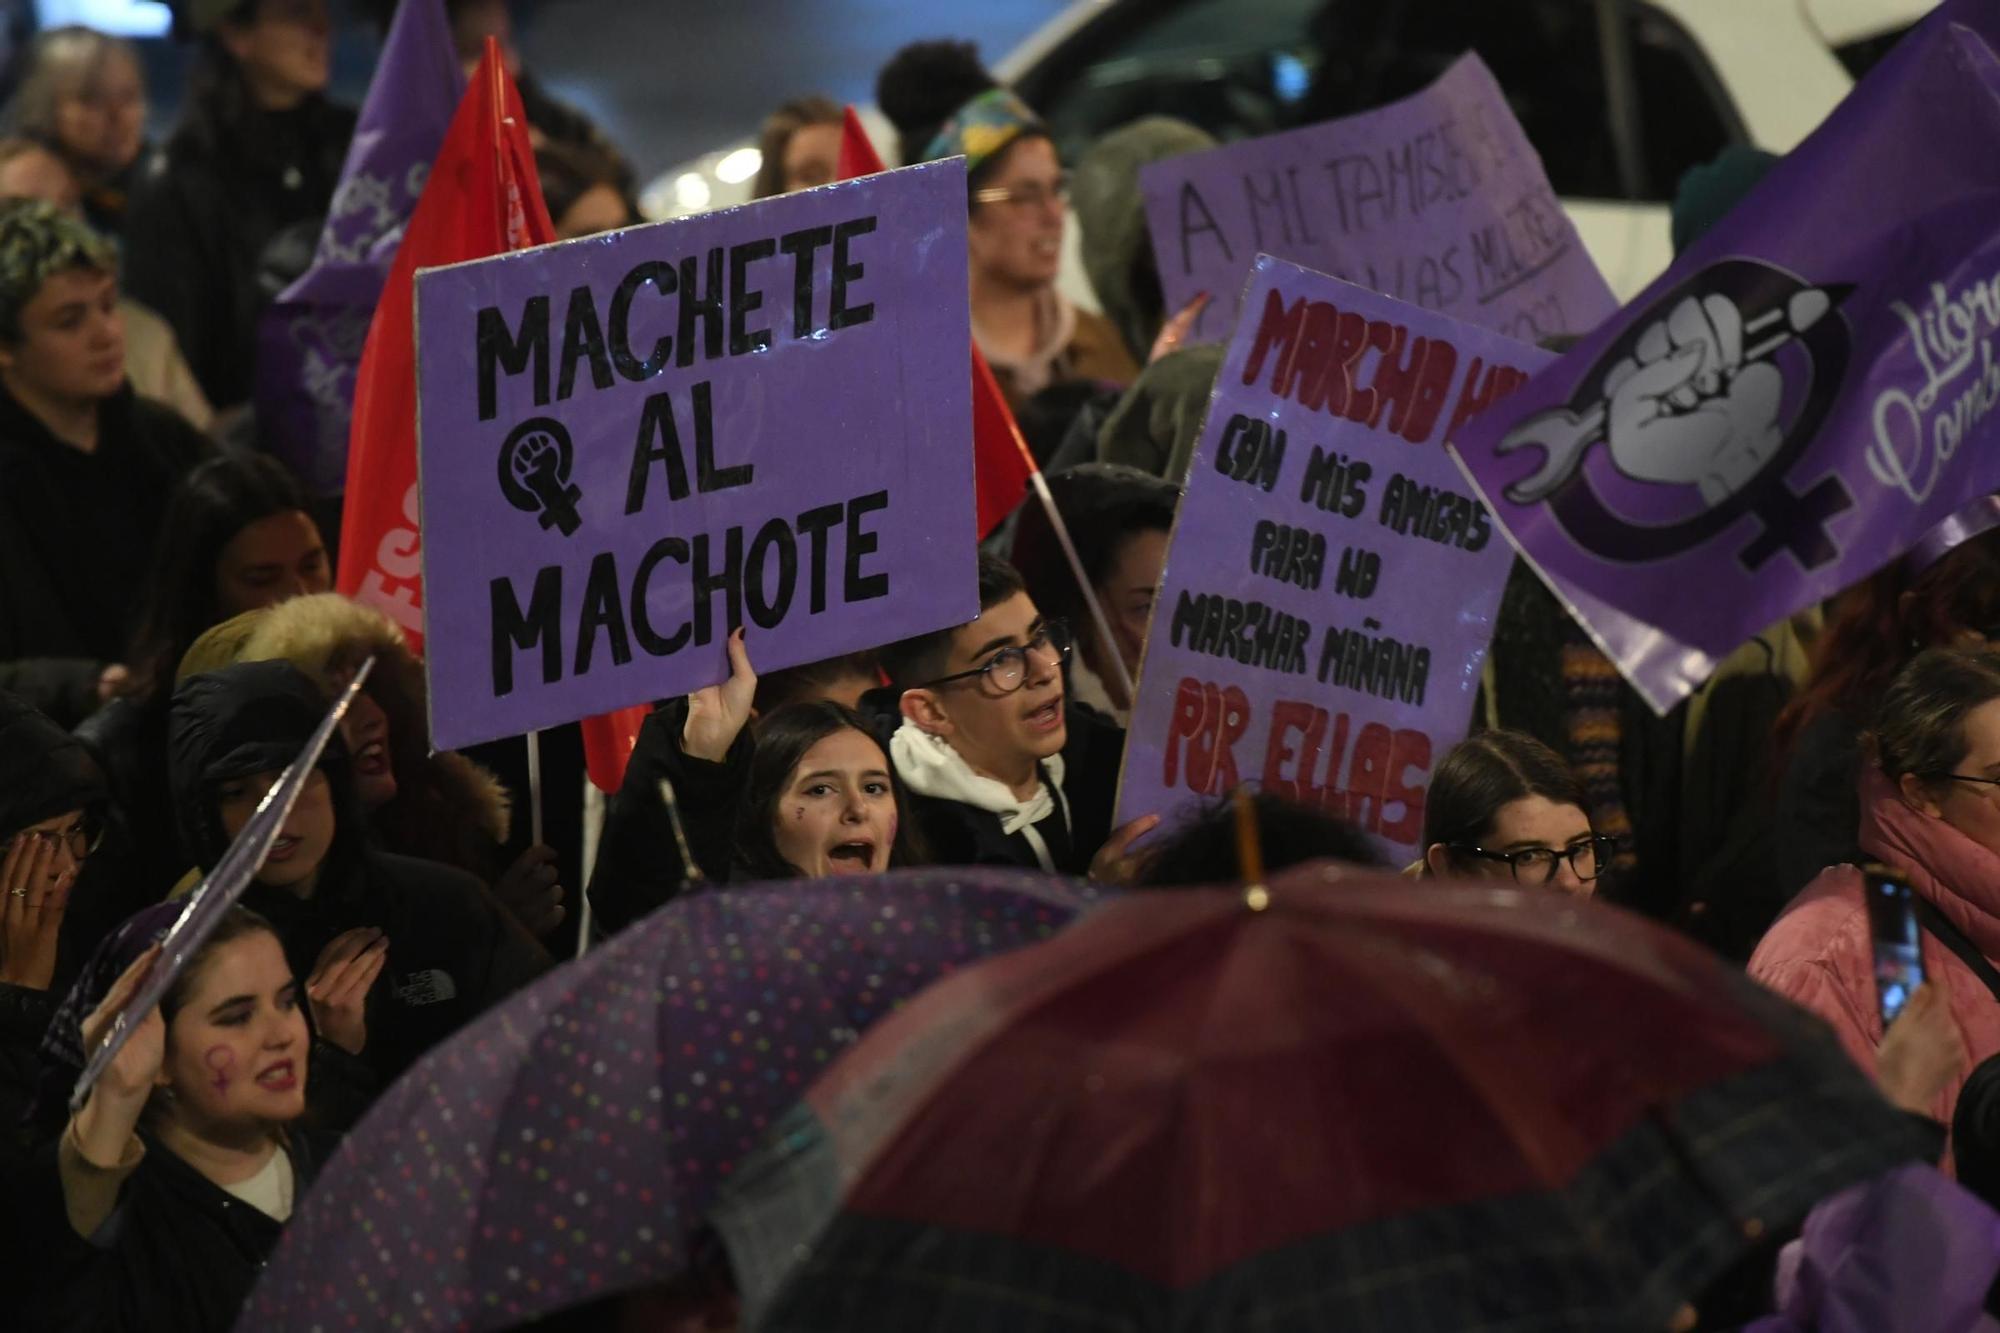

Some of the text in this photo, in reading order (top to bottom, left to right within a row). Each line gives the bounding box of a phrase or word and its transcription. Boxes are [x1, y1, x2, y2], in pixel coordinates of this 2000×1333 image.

[1179, 180, 1234, 276] A
[1243, 165, 1319, 250] MI
[476, 216, 877, 421] MACHETE
[1242, 288, 1457, 444] MARCHO
[624, 380, 754, 515] AL
[1215, 414, 1287, 492] CON
[489, 489, 889, 698] MACHOTE
[1250, 520, 1381, 599] PARA NO
[1170, 589, 1431, 707] MARCHAR MAÑANA
[1163, 676, 1432, 847] POR ELLAS
